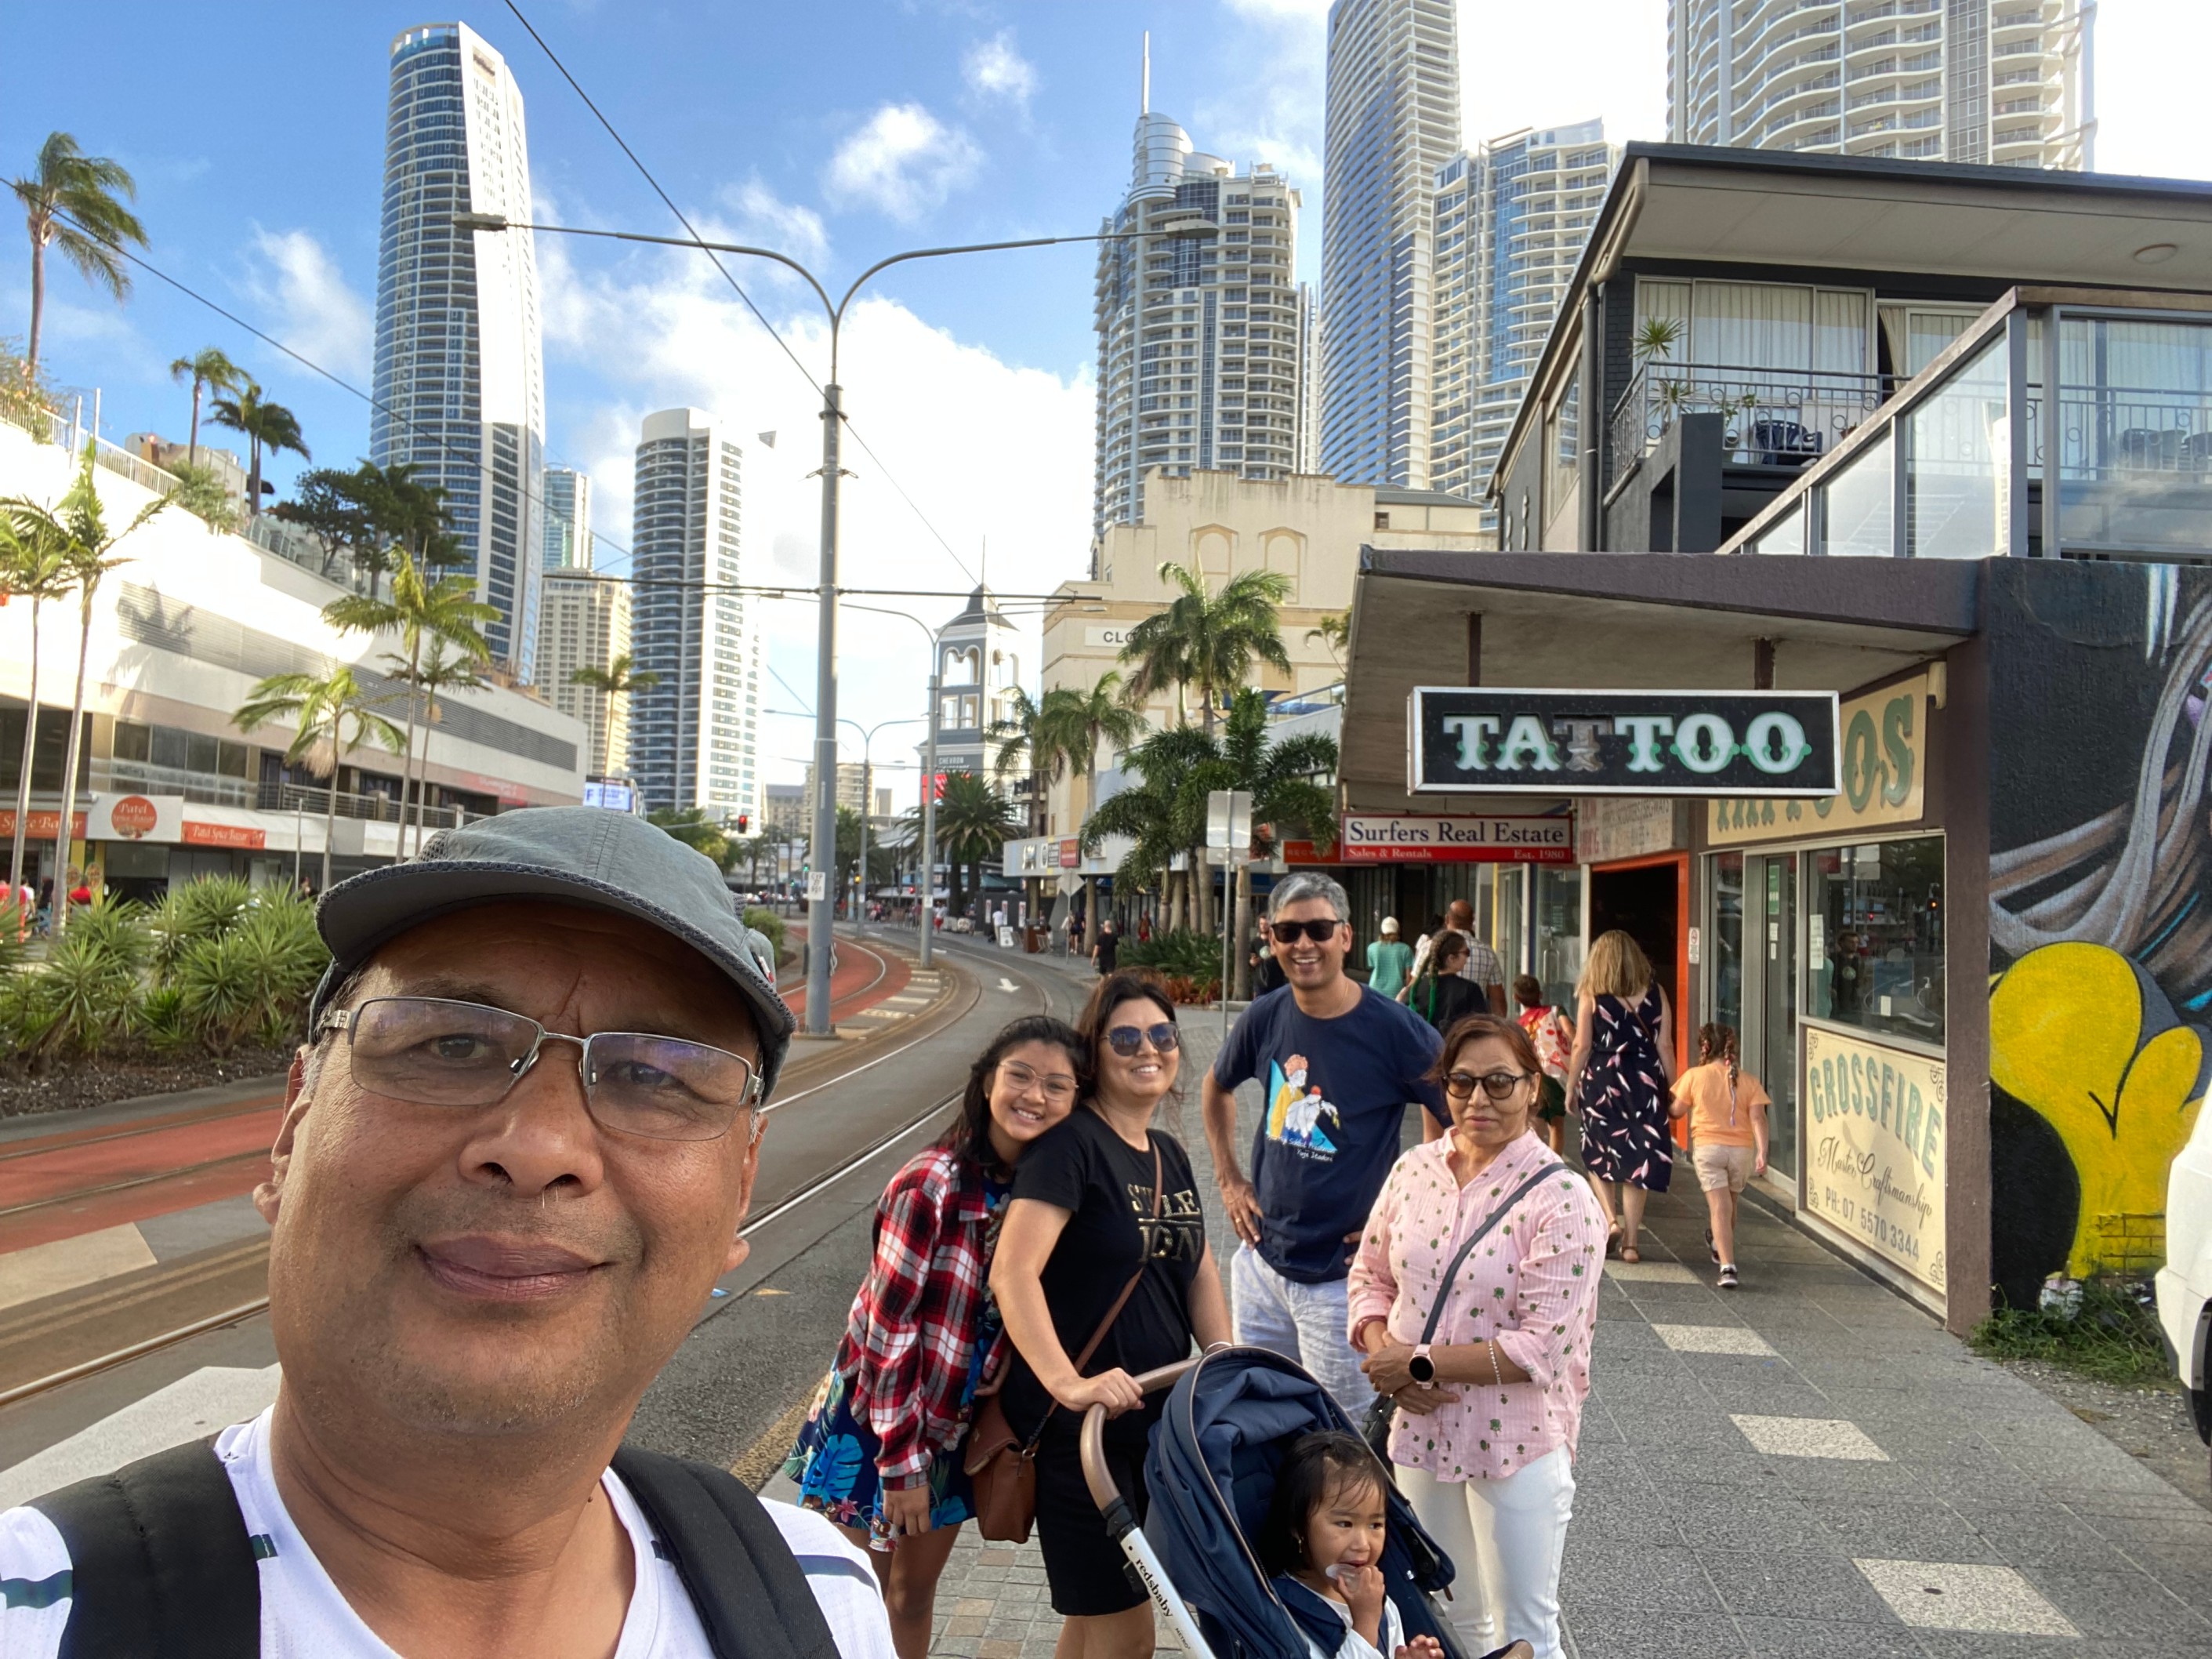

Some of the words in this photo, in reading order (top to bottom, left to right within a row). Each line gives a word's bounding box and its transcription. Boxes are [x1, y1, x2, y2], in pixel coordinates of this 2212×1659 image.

[1442, 711, 1812, 774] TATTOO
[118, 803, 147, 814] Patel
[1348, 847, 1376, 858] Sales
[1379, 848, 1388, 858] &
[1391, 848, 1432, 859] Rentals
[1350, 821, 1430, 842] Surfers
[1437, 822, 1485, 842] Real
[1493, 822, 1564, 843] Estate
[1513, 849, 1535, 859] Est.
[1539, 849, 1565, 859] 1980
[1809, 1052, 1942, 1181] CROSSFIRE
[1128, 1183, 1201, 1218] STLE
[1818, 1136, 1857, 1177] Master
[1856, 1153, 1932, 1230] Craftsmanship
[1826, 1186, 1840, 1214] PH:
[1842, 1200, 1855, 1222] 07
[1860, 1207, 1887, 1243] 5570
[1890, 1225, 1920, 1262] 3344
[1136, 1559, 1173, 1617] redsbaby
